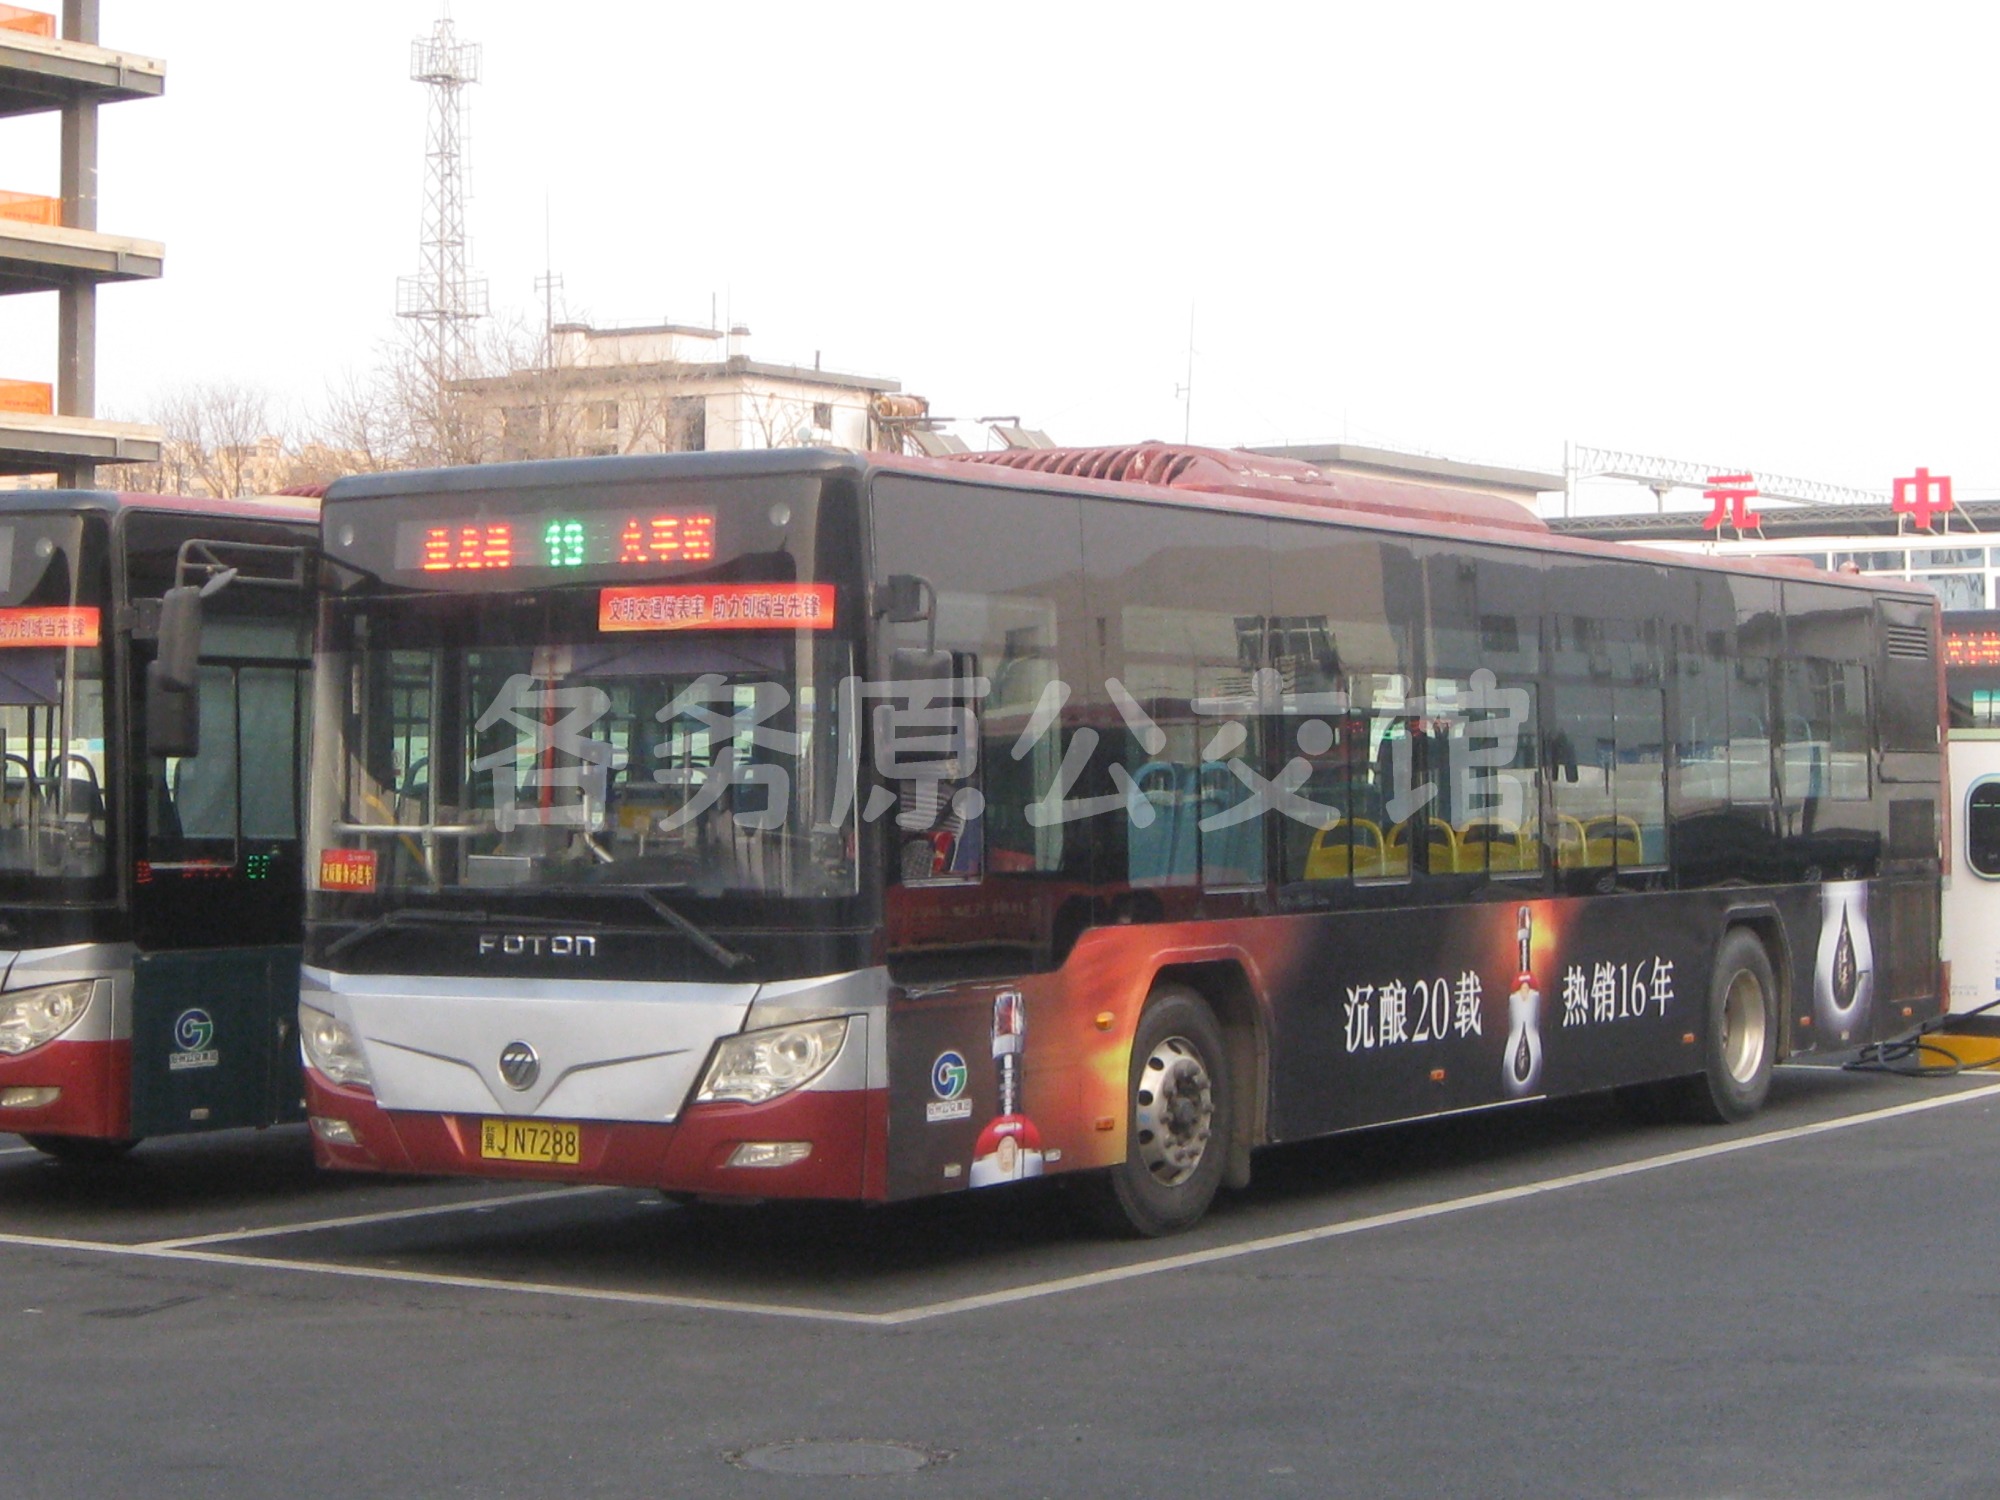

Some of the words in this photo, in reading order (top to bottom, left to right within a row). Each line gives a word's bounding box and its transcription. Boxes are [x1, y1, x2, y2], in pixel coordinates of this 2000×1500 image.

[1703, 474, 1761, 531] 元
[1892, 467, 1954, 529] 中
[712, 593, 820, 620] 助力创城当先锋
[479, 935, 596, 957] FOTON
[1343, 970, 1483, 1053] 沉酿20载
[1562, 955, 1675, 1028] 热销16年
